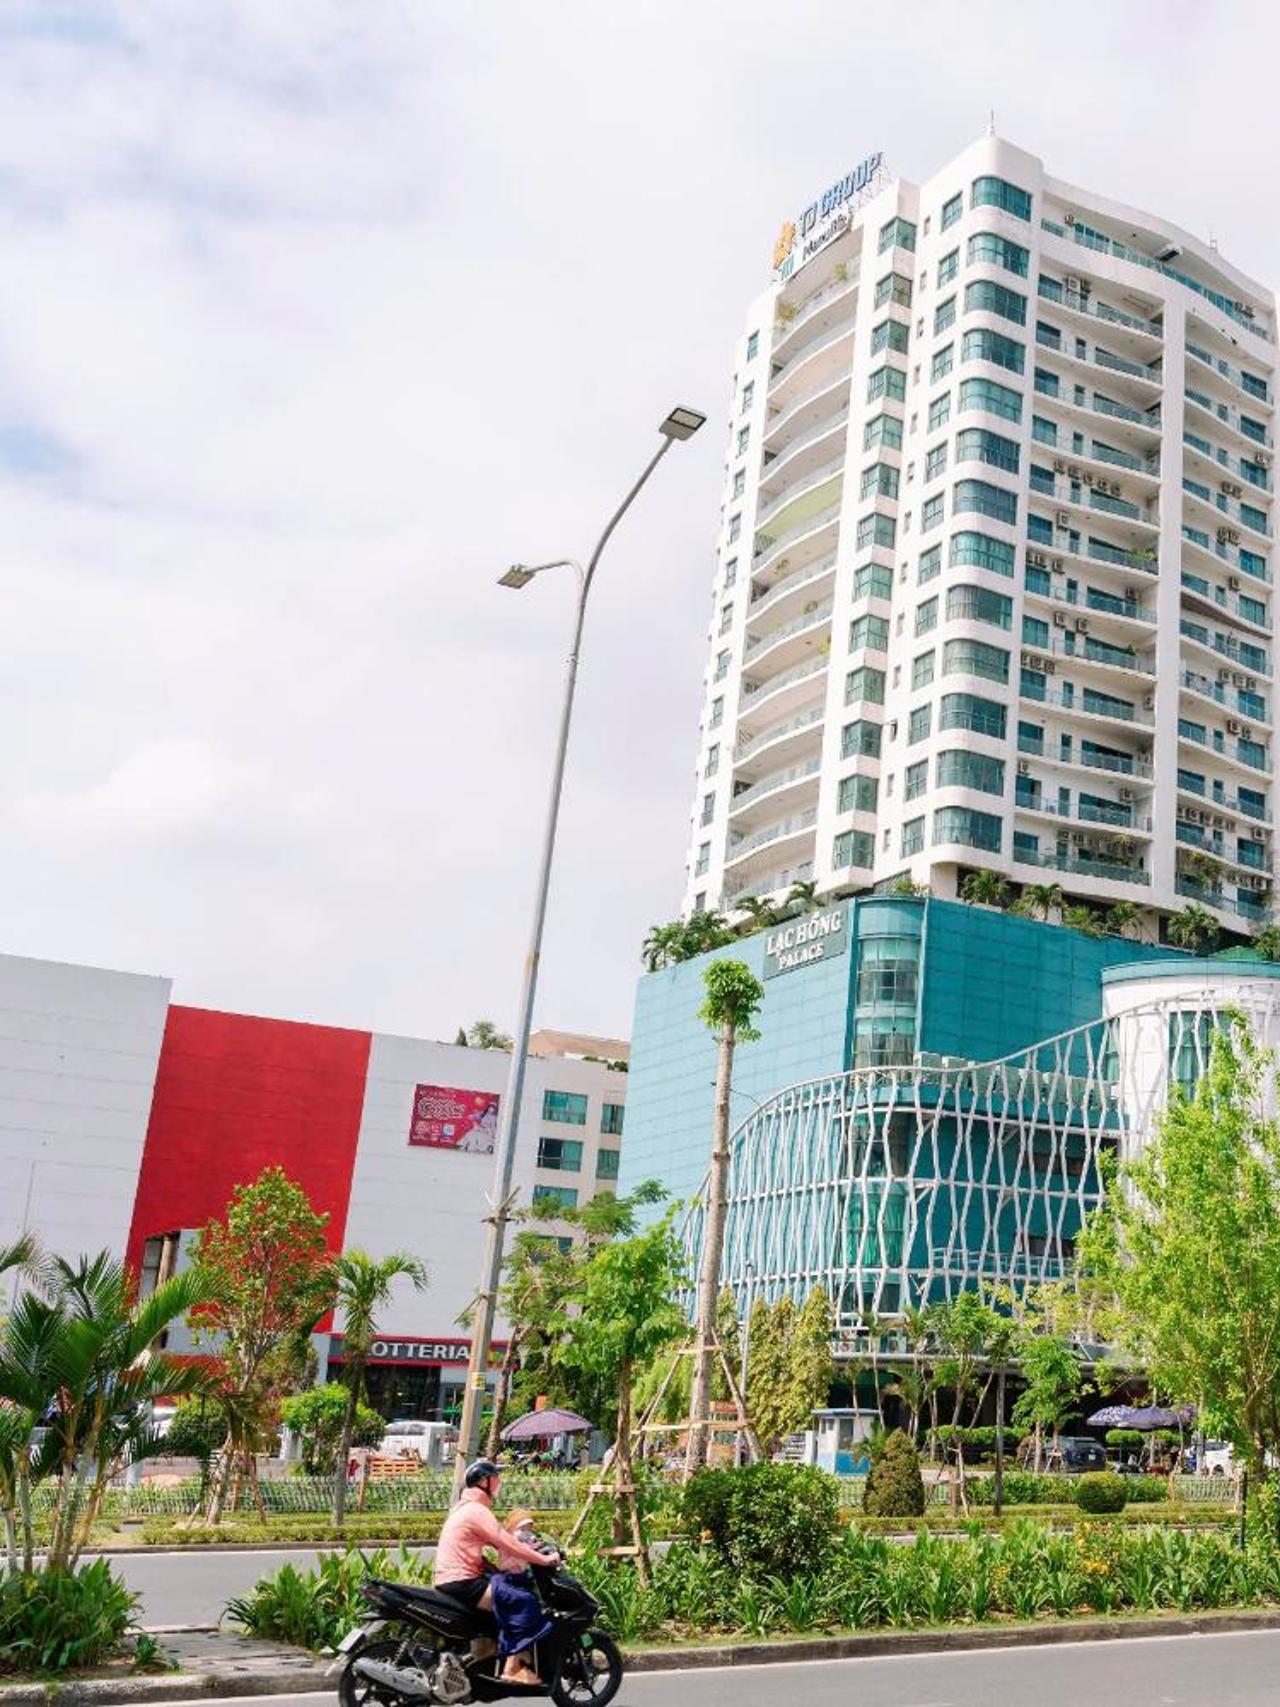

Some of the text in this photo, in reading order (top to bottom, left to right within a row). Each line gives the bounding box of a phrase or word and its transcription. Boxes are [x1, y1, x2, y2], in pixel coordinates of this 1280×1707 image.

[821, 152, 882, 218] GROUP
[779, 943, 824, 969] PALACE
[367, 1341, 470, 1360] OTTERIA
